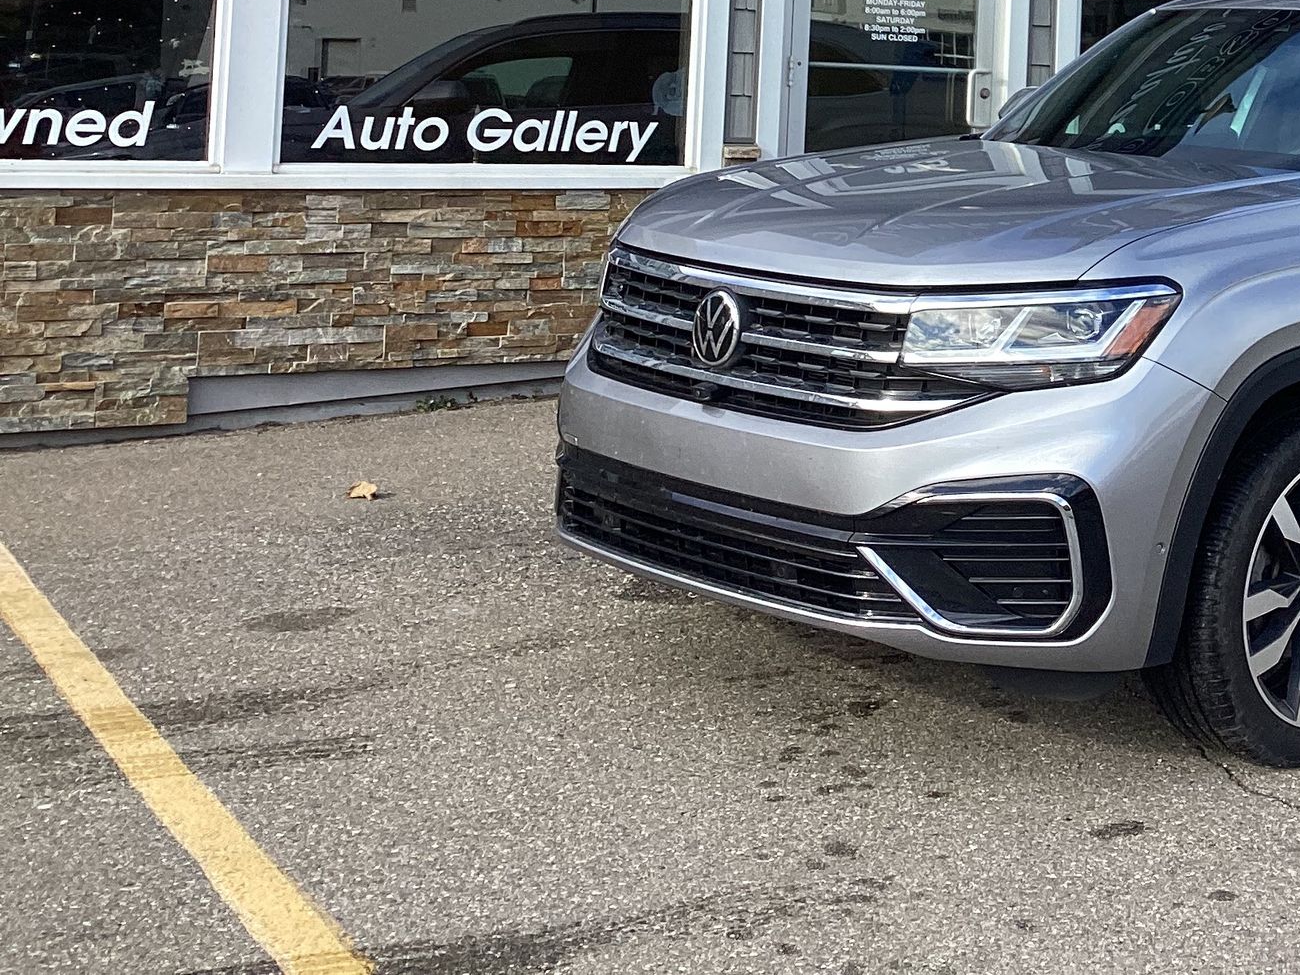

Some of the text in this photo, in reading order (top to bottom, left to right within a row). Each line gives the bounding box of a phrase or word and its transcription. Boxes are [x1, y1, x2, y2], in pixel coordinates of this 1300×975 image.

[876, 16, 915, 25] SATURDAY
[871, 33, 919, 43] SUN CLOSED
[310, 105, 659, 163] Auto Gallery
